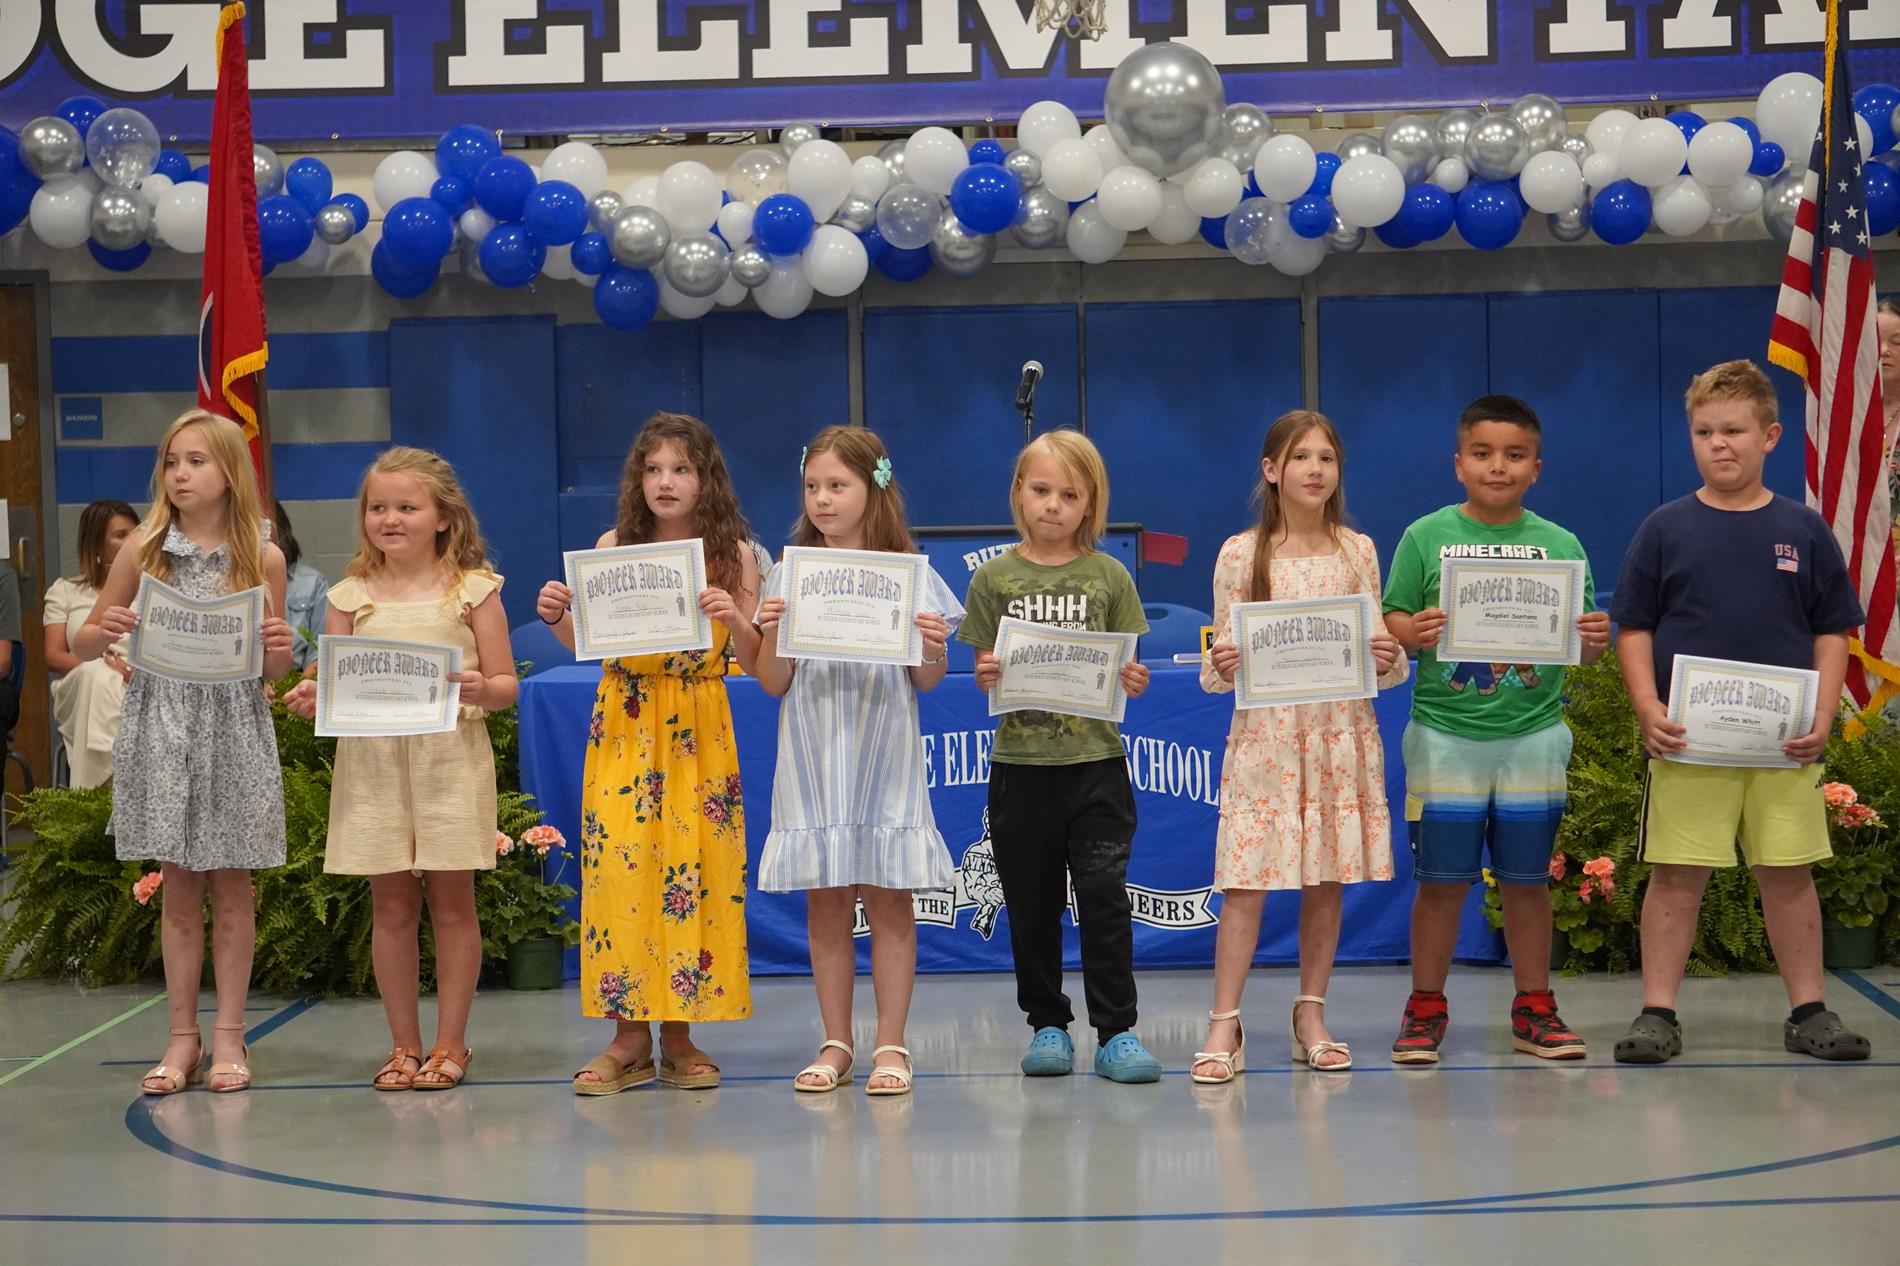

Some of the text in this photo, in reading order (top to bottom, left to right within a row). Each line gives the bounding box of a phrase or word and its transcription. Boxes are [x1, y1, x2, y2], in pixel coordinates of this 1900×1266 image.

[1440, 544, 1548, 560] MINECRAFT
[1774, 543, 1800, 561] USA
[586, 562, 683, 603] PIONEER AWARD
[801, 568, 901, 602] PIONEER AWARD
[1459, 576, 1560, 608] PIONEER AWARD
[149, 606, 243, 636] PIONEER AWARD
[1008, 594, 1087, 621] SHHH
[1252, 616, 1351, 654] PIONEER AWARD
[338, 651, 439, 680] PIONEER AWARD
[1010, 643, 1109, 667] PIONEER AWARD
[1689, 680, 1792, 714] PIONEER AWARD
[918, 898, 949, 916] THE
